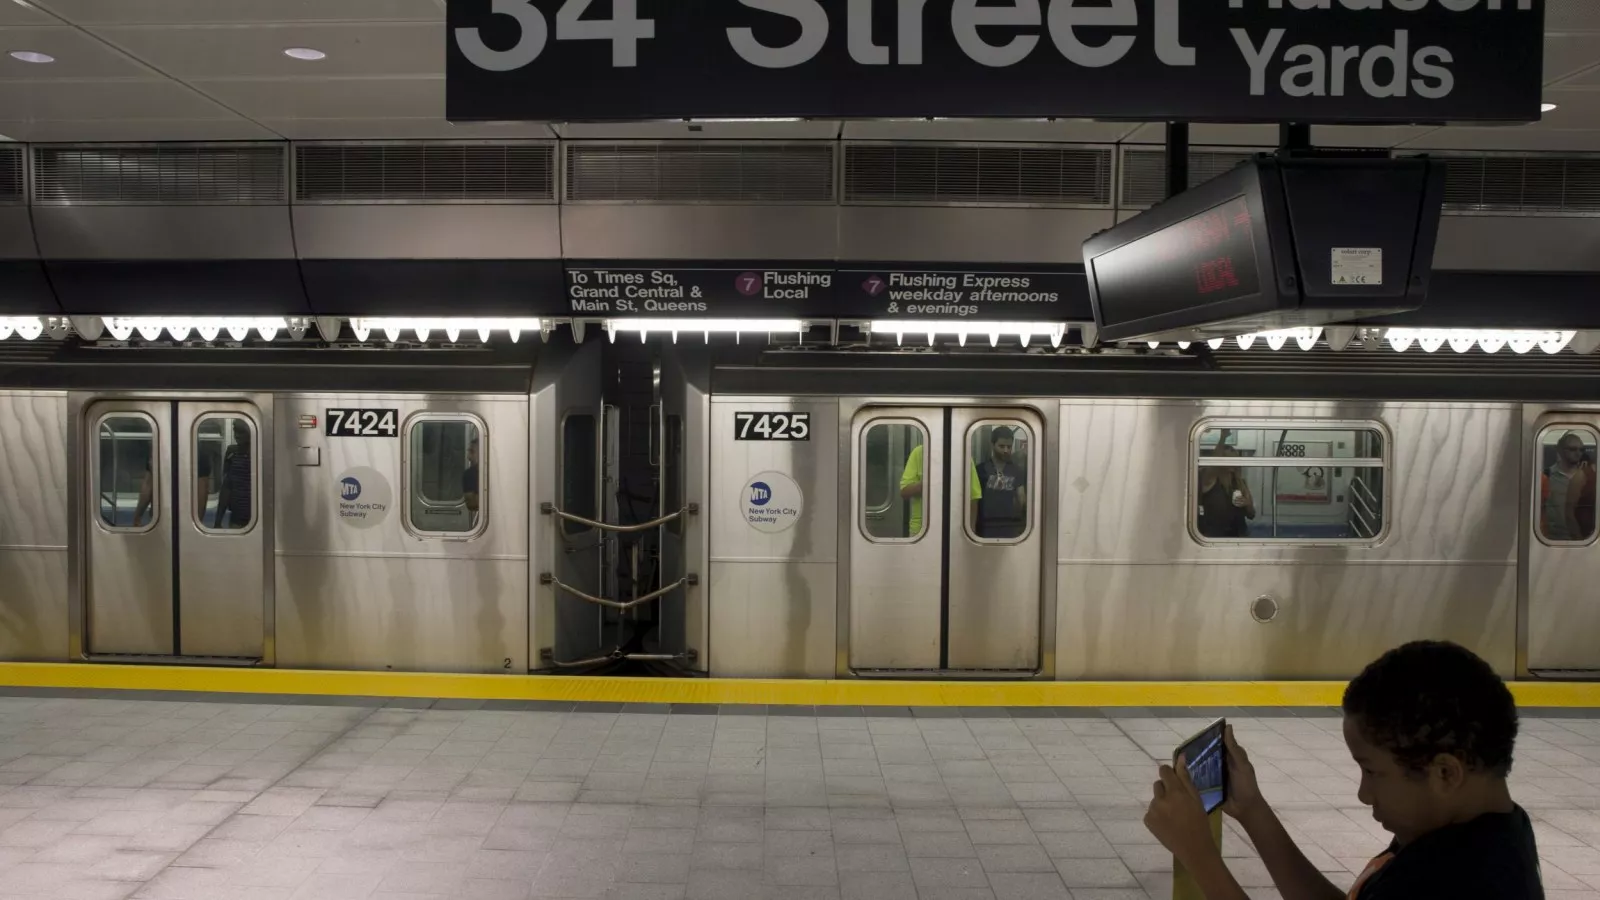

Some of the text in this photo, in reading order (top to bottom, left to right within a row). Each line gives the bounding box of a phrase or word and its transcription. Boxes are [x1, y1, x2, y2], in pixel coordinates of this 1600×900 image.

[1229, 28, 1454, 98] Yards
[568, 270, 678, 286] To Times Sq,
[743, 277, 755, 291] 7
[764, 272, 831, 287] Flushing
[889, 273, 1030, 290] Flushing Express
[570, 285, 702, 298] Grand Central &
[764, 286, 809, 299] Local
[868, 280, 880, 294] 7
[889, 288, 1059, 303] weekday afternoons
[571, 299, 707, 312] Main St, Queens
[887, 302, 978, 316] & evenings
[328, 410, 396, 435] 7424
[737, 414, 808, 438] 7425
[340, 481, 358, 496] MTA
[749, 486, 768, 501] MTA
[339, 502, 355, 510] New
[372, 503, 386, 512] City
[748, 507, 765, 515] New
[782, 508, 797, 517] City
[339, 510, 367, 519] Subway
[748, 515, 777, 524] Subway
[504, 657, 512, 669] 2
